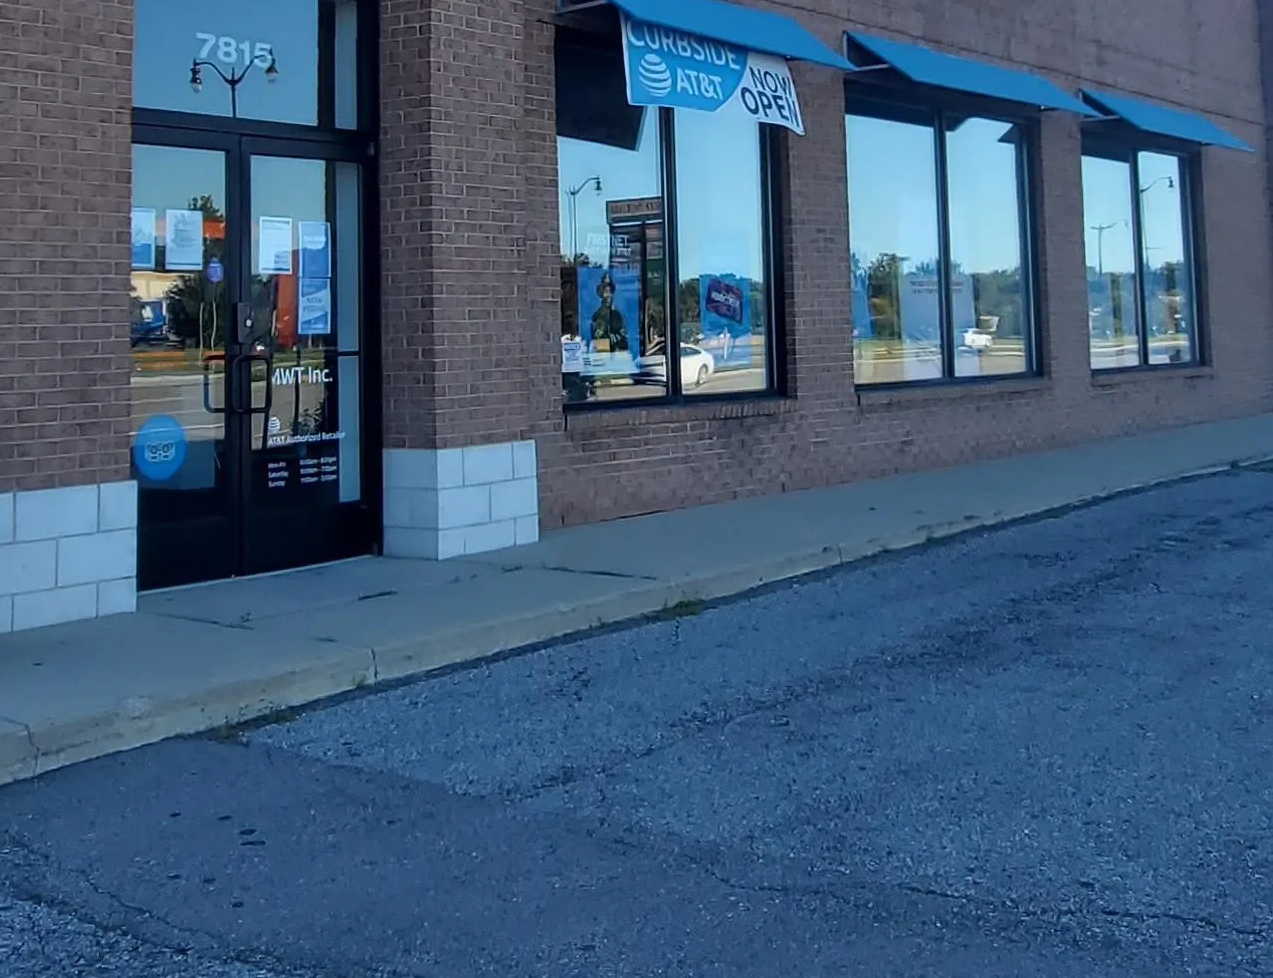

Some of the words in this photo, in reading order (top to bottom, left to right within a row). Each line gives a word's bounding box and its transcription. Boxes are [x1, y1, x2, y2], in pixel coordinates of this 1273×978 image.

[196, 32, 273, 68] 7815
[628, 20, 742, 71] CURBSIDE
[676, 67, 725, 101] AT&T
[749, 66, 795, 99] NOW
[740, 86, 800, 128] OPEN
[308, 366, 333, 384] Inc.
